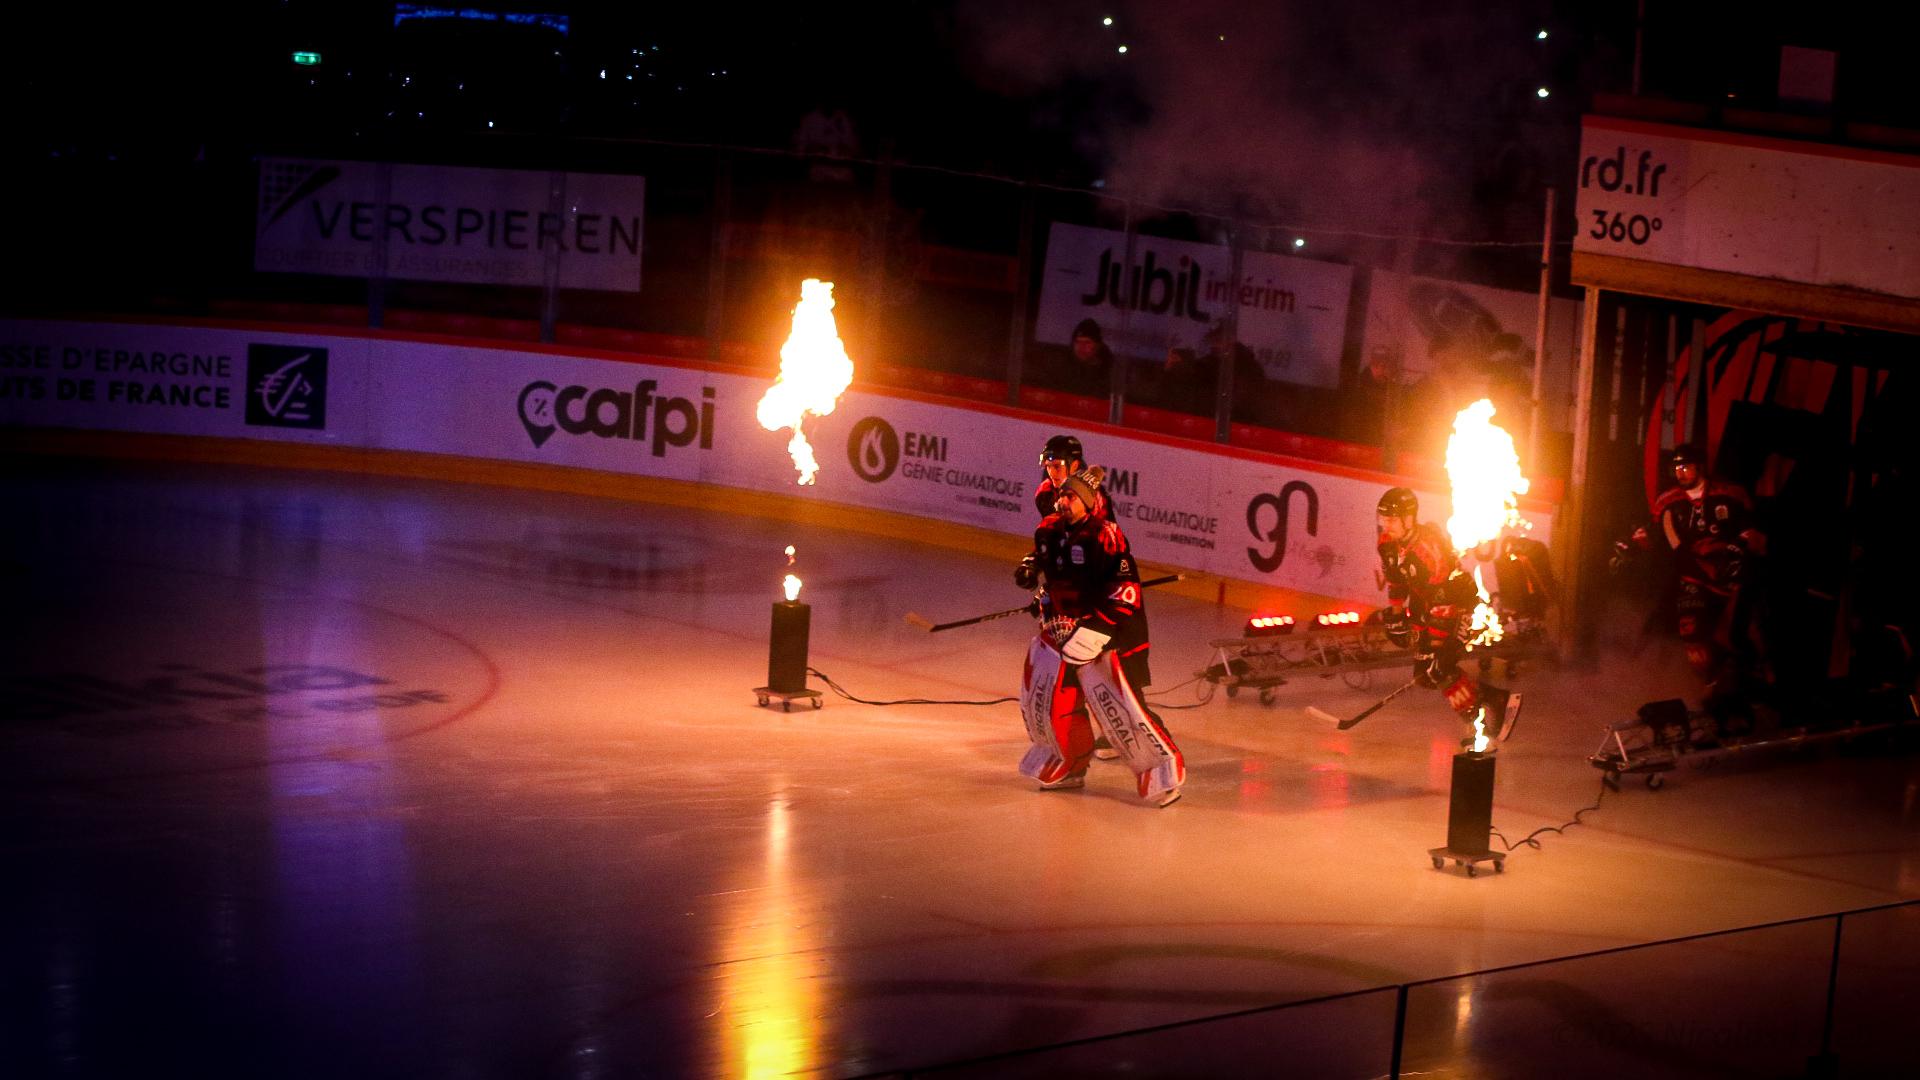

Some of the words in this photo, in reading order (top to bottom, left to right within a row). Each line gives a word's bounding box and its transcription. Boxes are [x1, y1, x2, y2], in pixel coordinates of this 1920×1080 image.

[1582, 147, 1666, 197] rd.fr
[311, 201, 641, 255] VERSPIEREN
[63, 347, 232, 378] D'EPARGNE
[57, 377, 97, 402] DE
[109, 380, 231, 409] FRANCE
[554, 380, 716, 457] cafpi
[904, 432, 948, 462] EMI
[946, 469, 1025, 498] CLIMATIQUE
[1136, 505, 1219, 535] CLIMATIQUE
[1097, 690, 1136, 750] SICRAL
[1138, 721, 1169, 757] CCM
